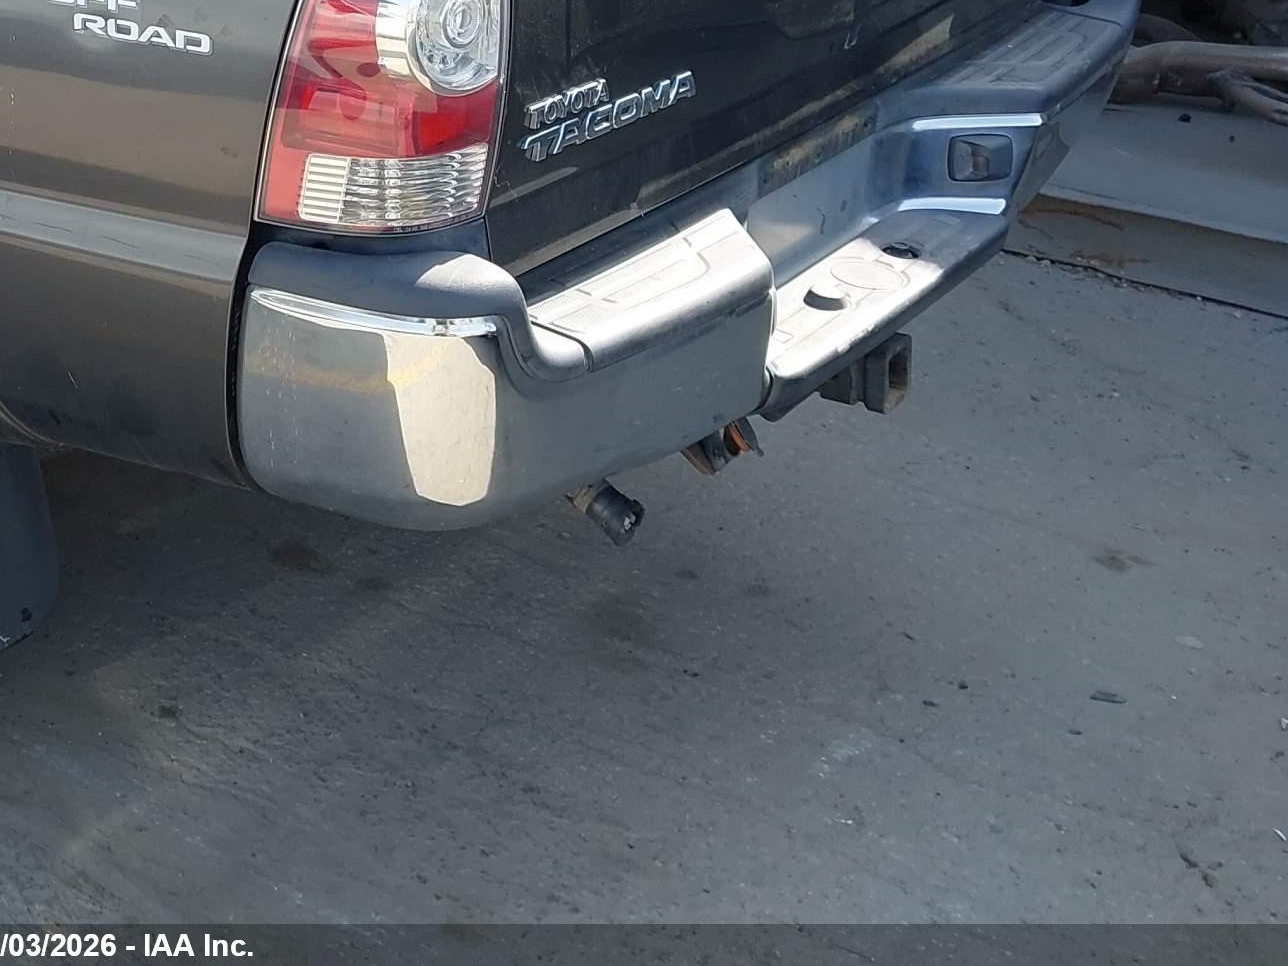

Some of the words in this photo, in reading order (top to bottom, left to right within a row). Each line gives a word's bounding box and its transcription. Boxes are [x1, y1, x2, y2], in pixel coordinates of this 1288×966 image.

[72, 12, 213, 54] ROAD
[520, 70, 697, 162] TACOMA
[524, 78, 610, 130] TOYOTA
